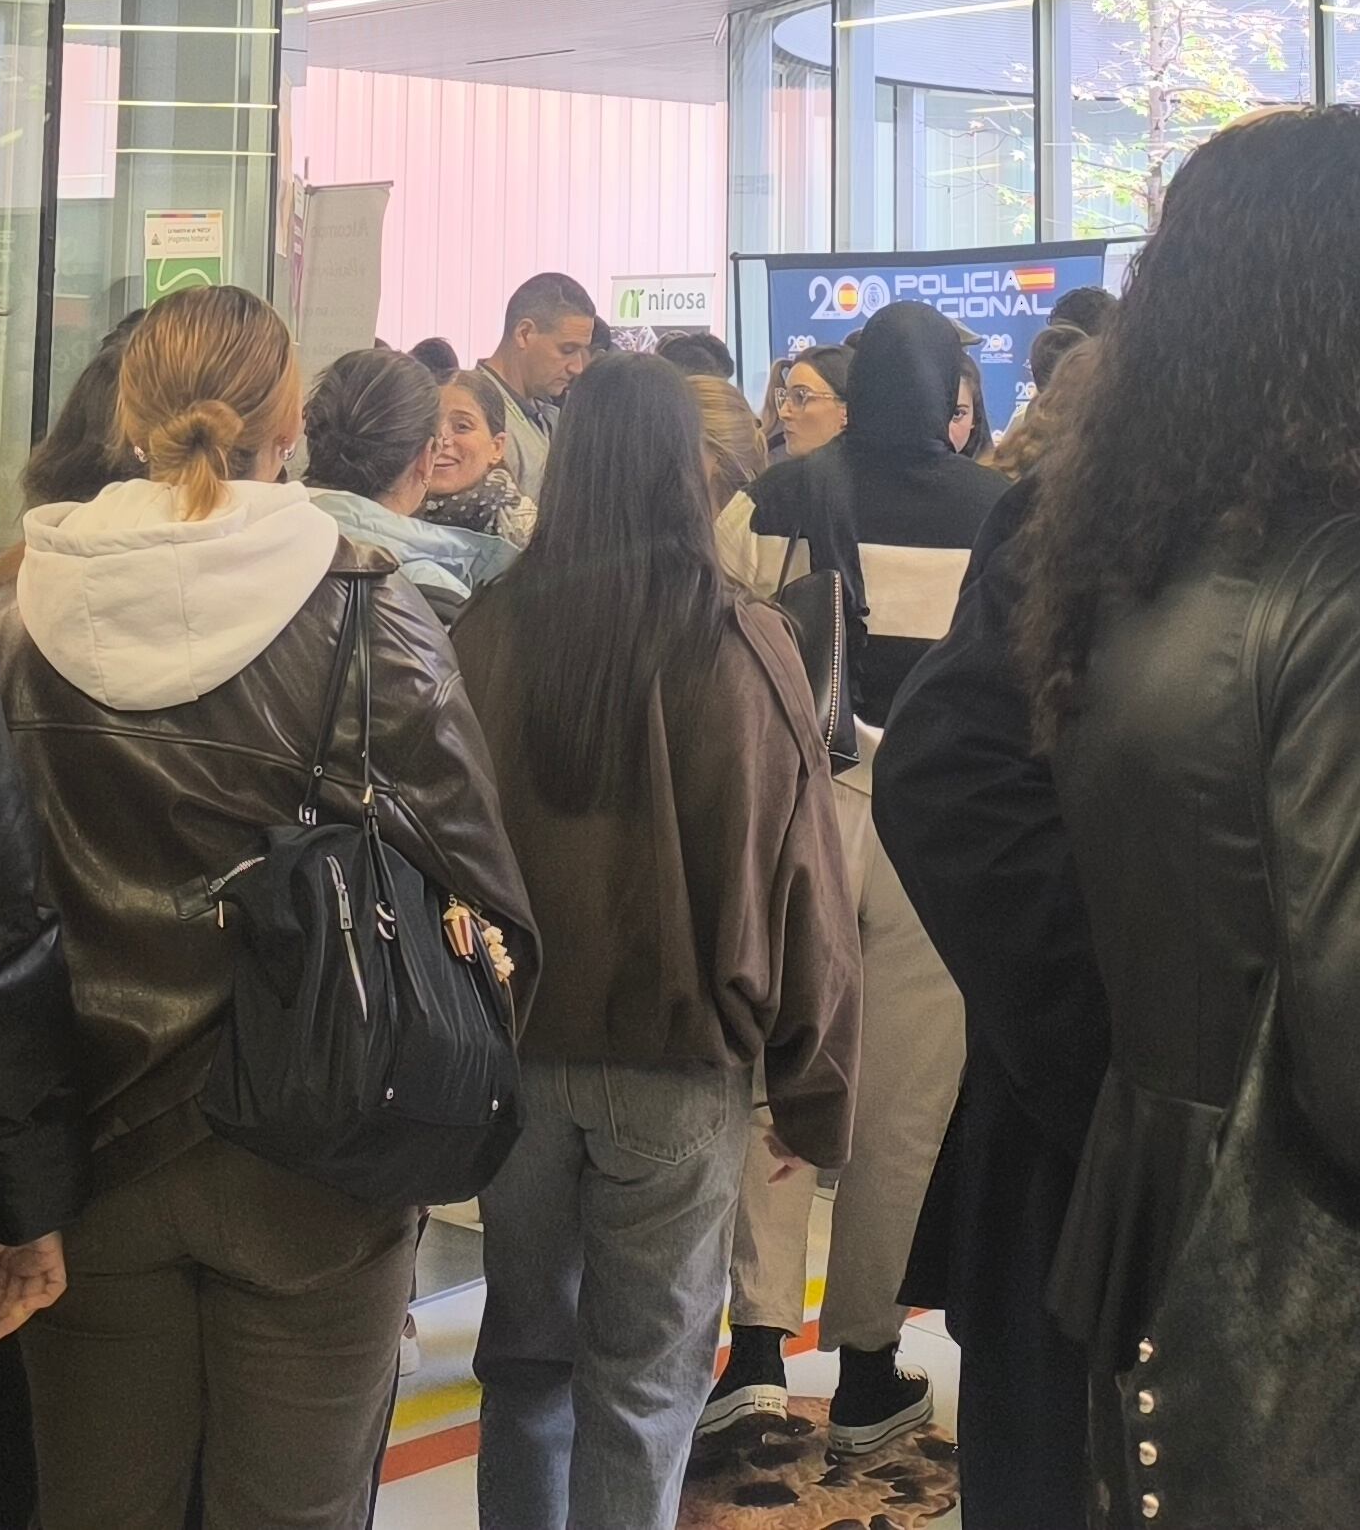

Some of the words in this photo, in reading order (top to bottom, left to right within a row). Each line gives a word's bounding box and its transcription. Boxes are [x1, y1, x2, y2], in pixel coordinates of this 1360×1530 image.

[894, 270, 1021, 297] POLICIA
[648, 288, 706, 311] nirosa
[808, 275, 891, 320] 200
